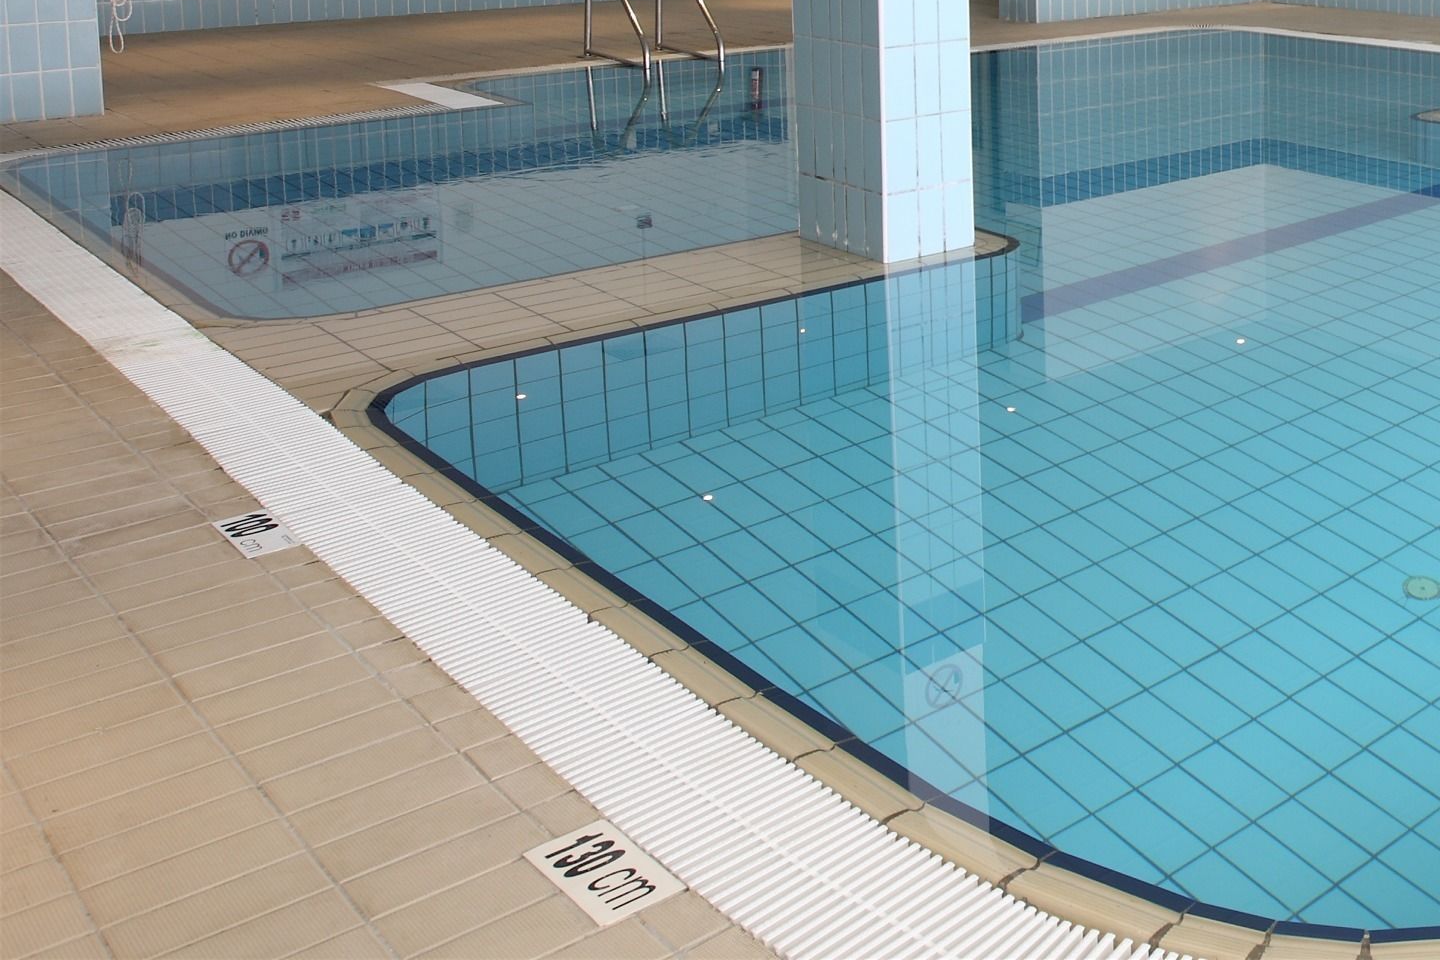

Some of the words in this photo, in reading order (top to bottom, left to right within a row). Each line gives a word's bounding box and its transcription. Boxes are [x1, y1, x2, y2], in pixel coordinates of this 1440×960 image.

[220, 513, 279, 538] 100
[240, 538, 263, 553] cm
[544, 832, 626, 878] 130
[587, 867, 657, 911] cm
